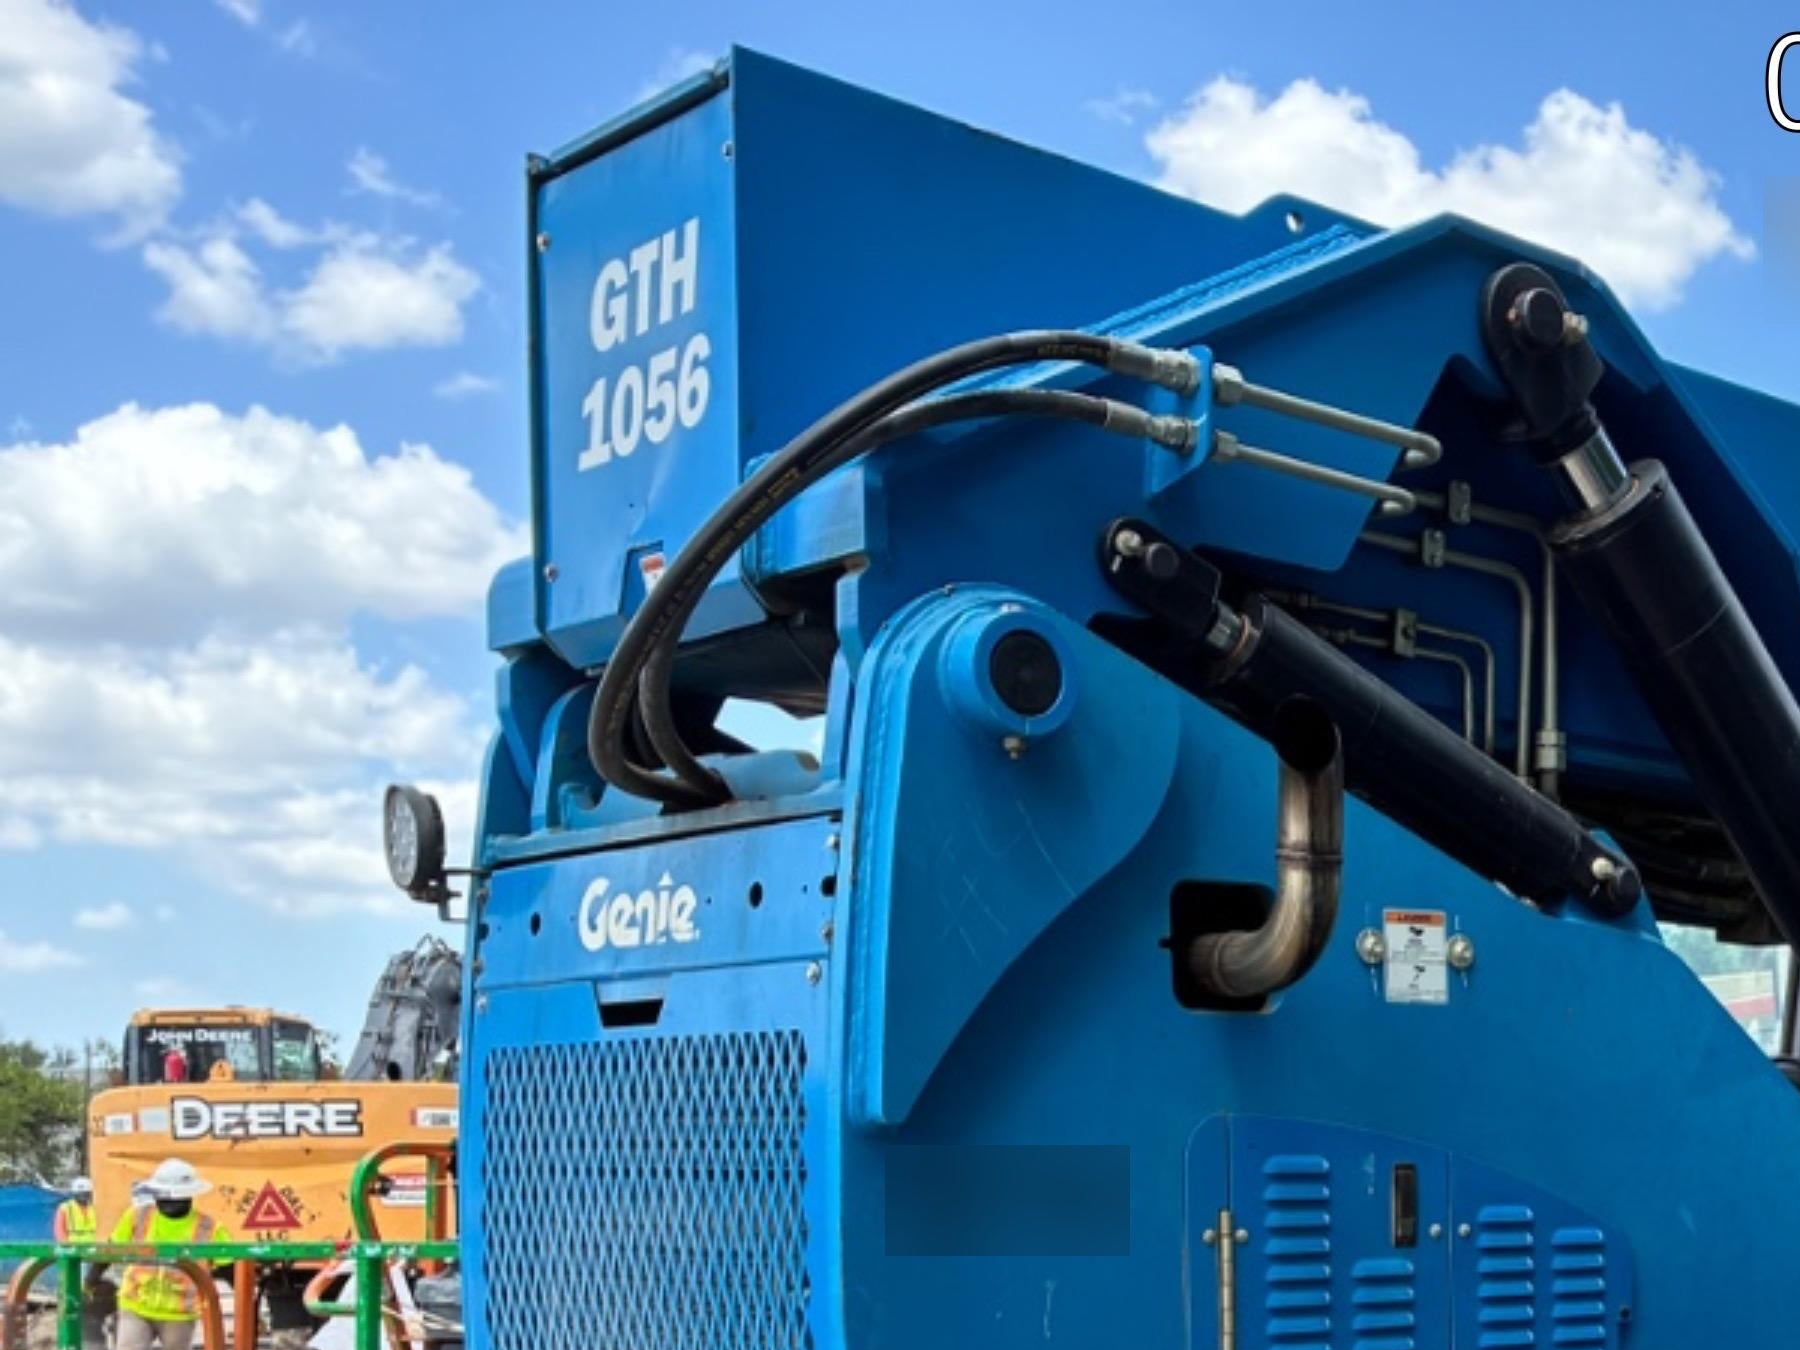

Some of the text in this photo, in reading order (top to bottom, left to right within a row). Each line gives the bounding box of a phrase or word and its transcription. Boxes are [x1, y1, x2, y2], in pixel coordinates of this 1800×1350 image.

[590, 218, 701, 353] GTH
[577, 333, 712, 473] 1056
[578, 870, 699, 952] Genie
[171, 1097, 363, 1140] DEERE
